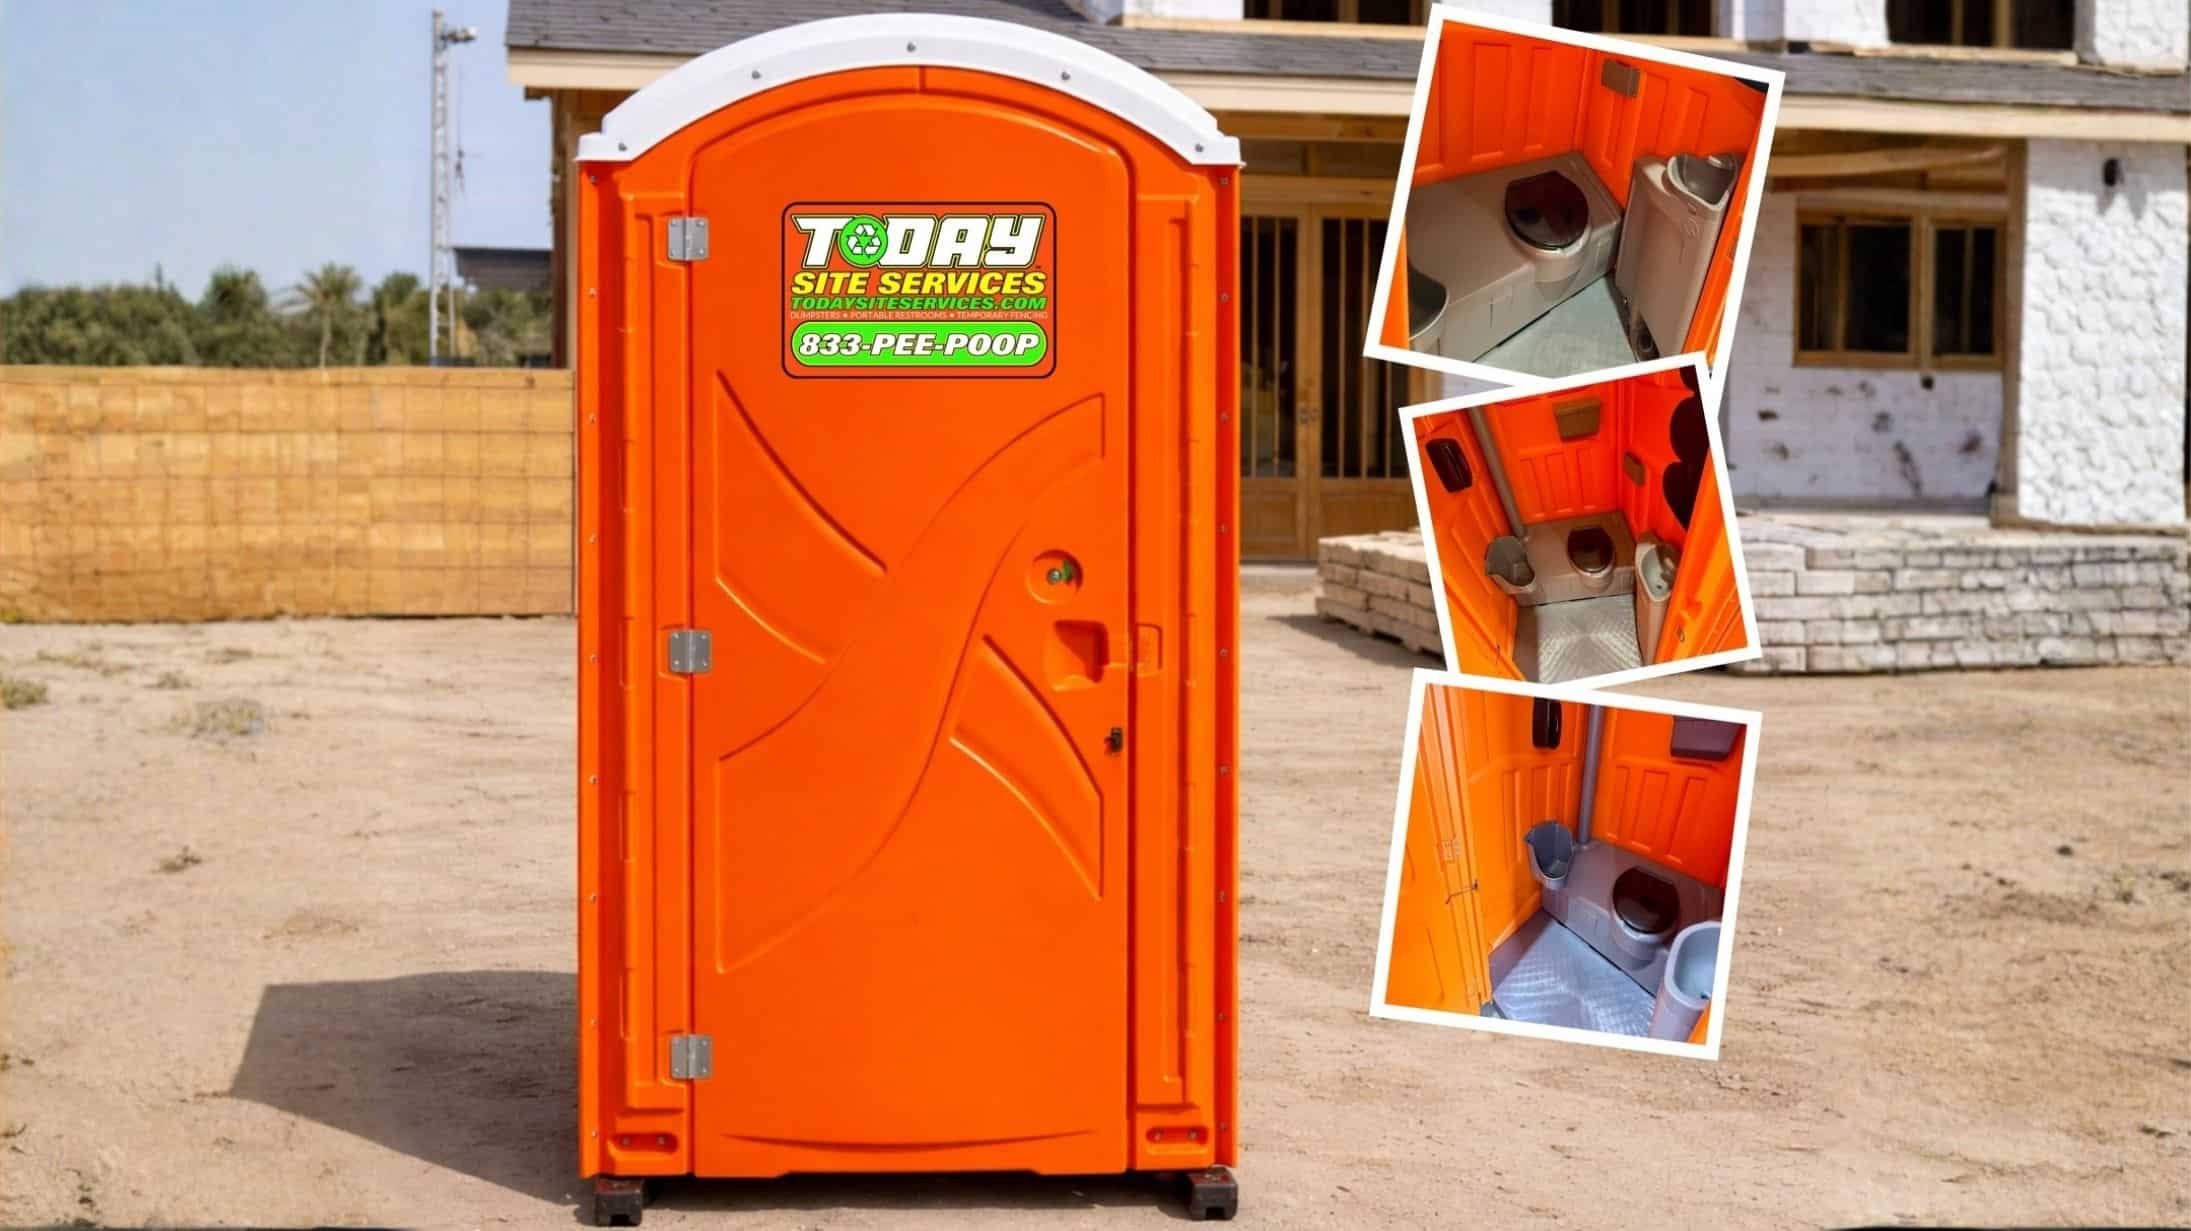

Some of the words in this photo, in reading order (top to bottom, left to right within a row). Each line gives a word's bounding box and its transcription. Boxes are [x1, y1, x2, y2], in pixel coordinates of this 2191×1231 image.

[791, 271, 870, 295] SITE
[878, 271, 1046, 295] SERVICES
[790, 296, 1047, 311] TODAYSITESERVICES.COM
[790, 311, 841, 320] DUMPSTERS
[850, 311, 893, 320] PORTABLE
[895, 311, 948, 320] RESTROOMS
[957, 311, 1009, 320] TEMPORARY
[1011, 311, 1048, 320] FENCING
[799, 333, 1039, 356] 833-PEE-POOP
